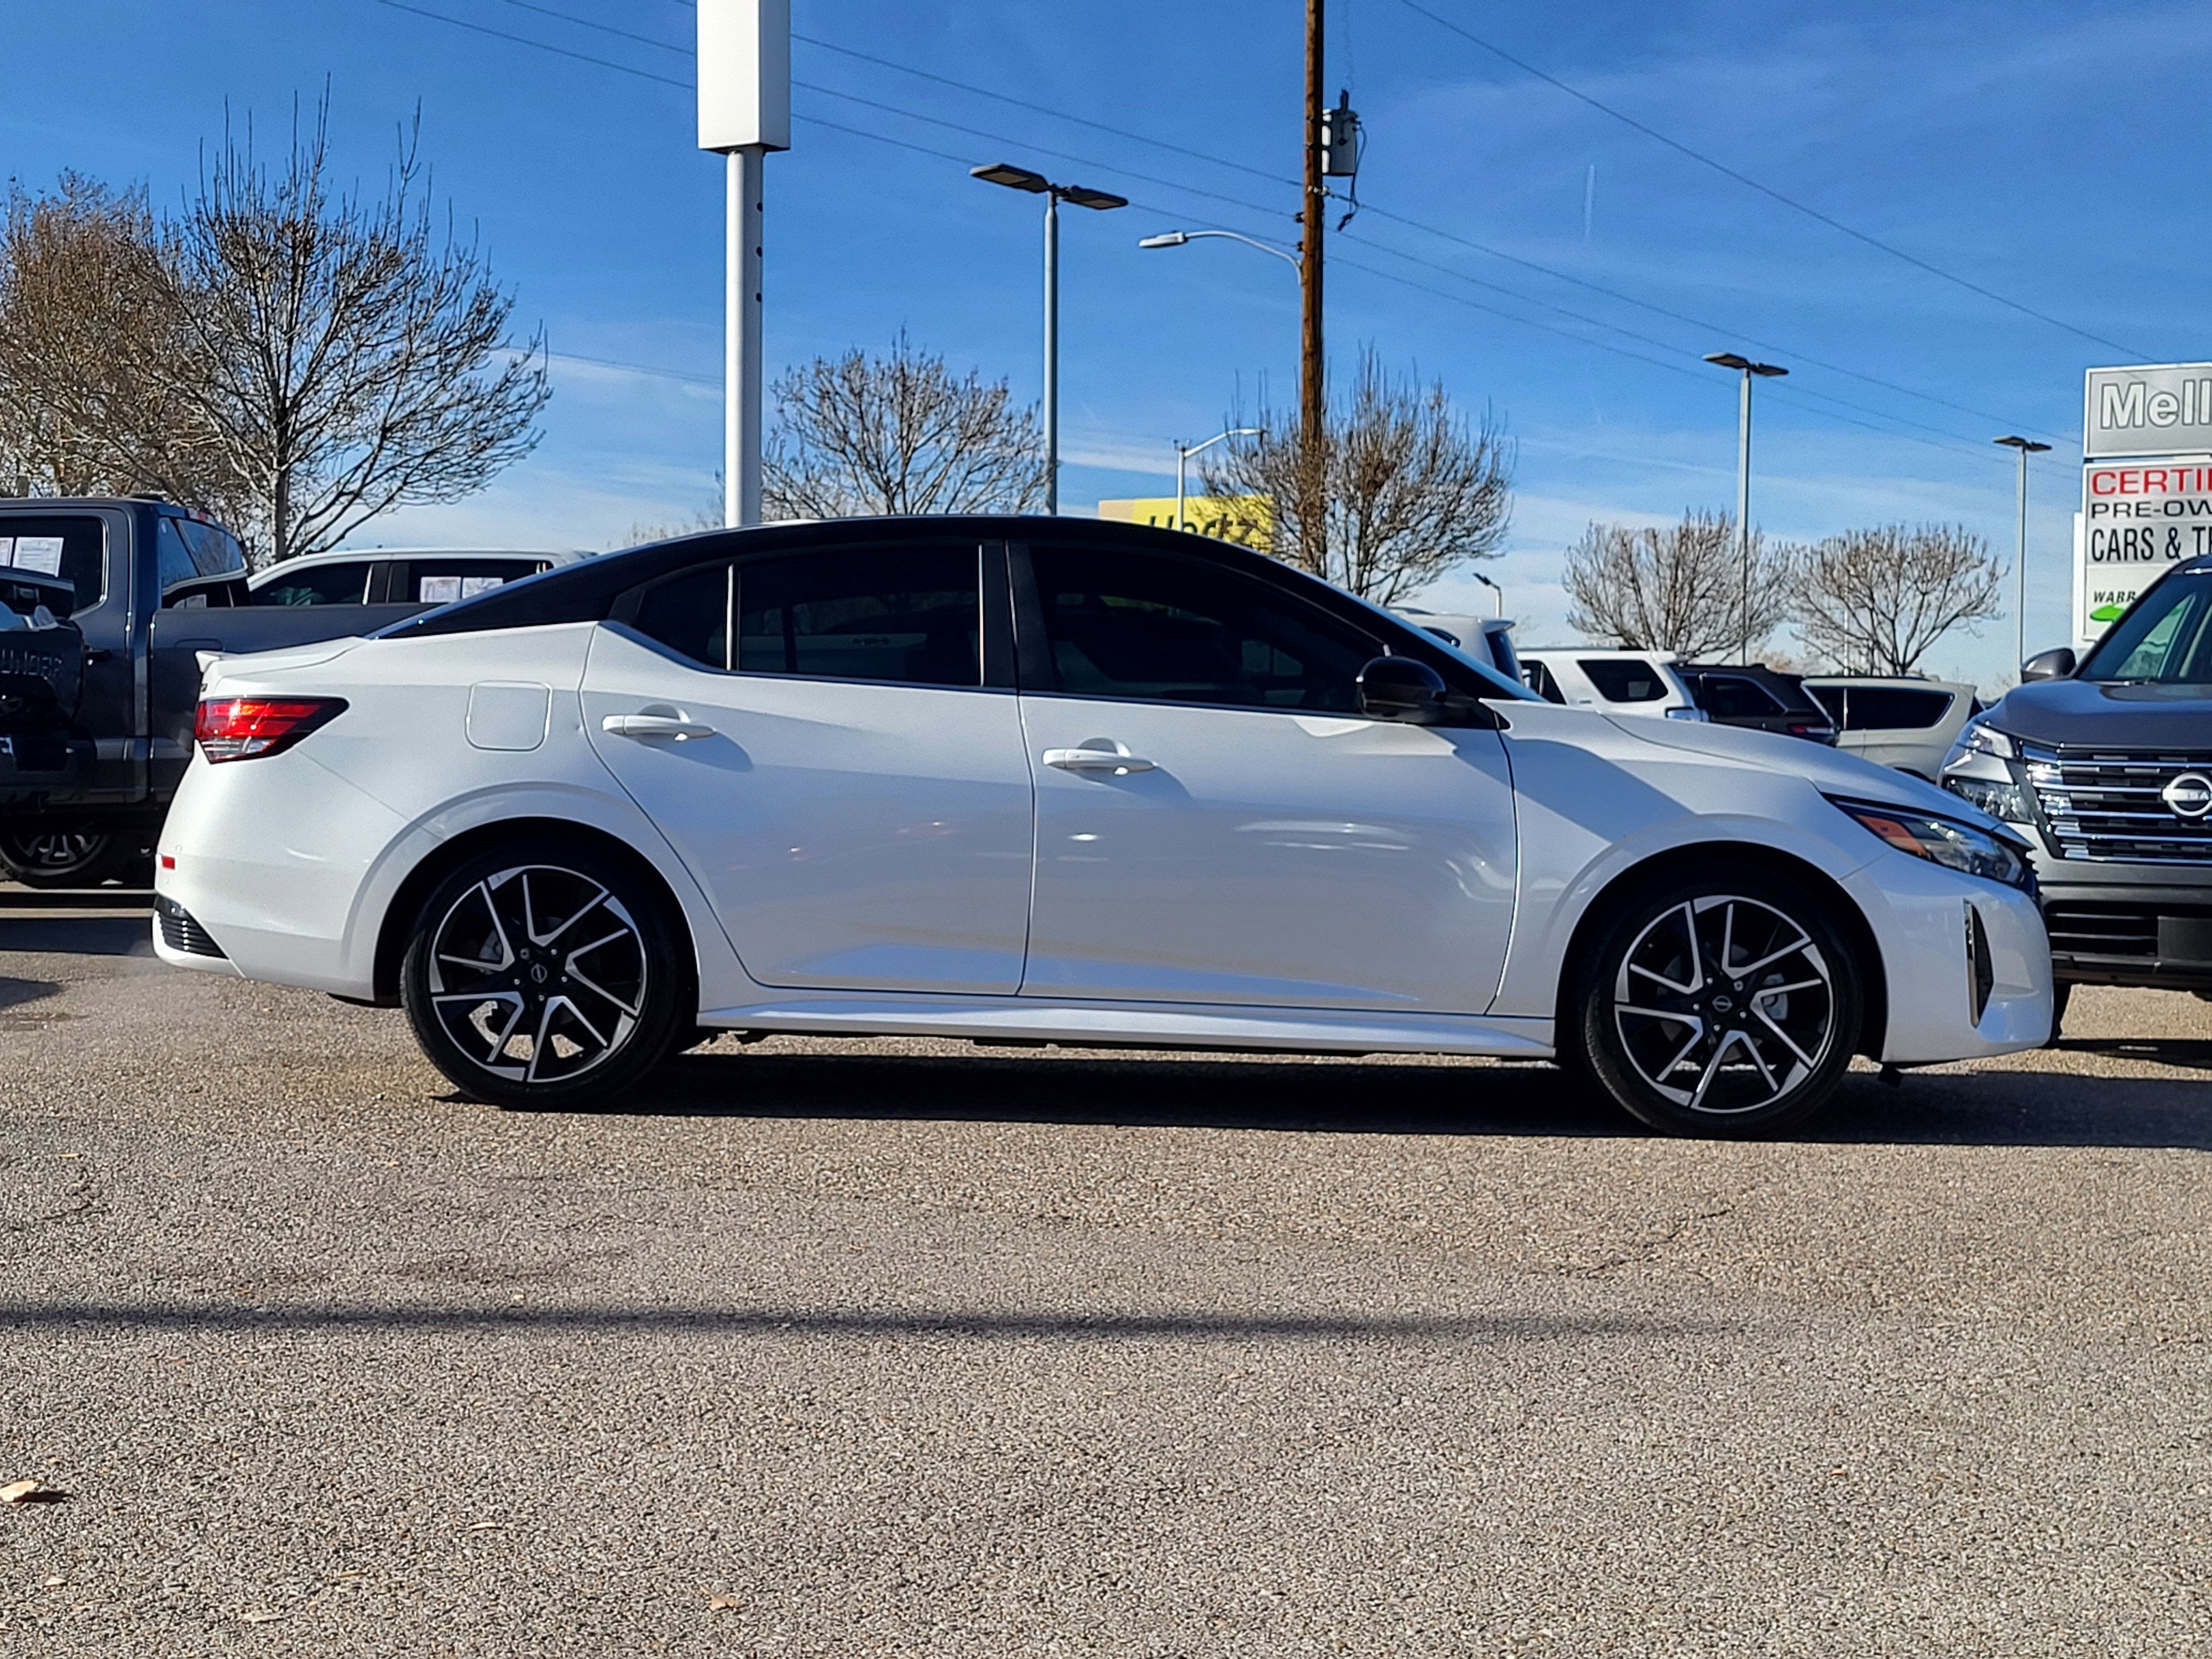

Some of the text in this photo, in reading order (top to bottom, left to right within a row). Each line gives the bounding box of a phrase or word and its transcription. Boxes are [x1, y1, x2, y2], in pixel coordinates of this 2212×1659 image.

[2101, 378, 2211, 429] Mell
[2092, 468, 2212, 495] CERTI
[2092, 527, 2154, 561] CARS
[2166, 527, 2181, 559] &
